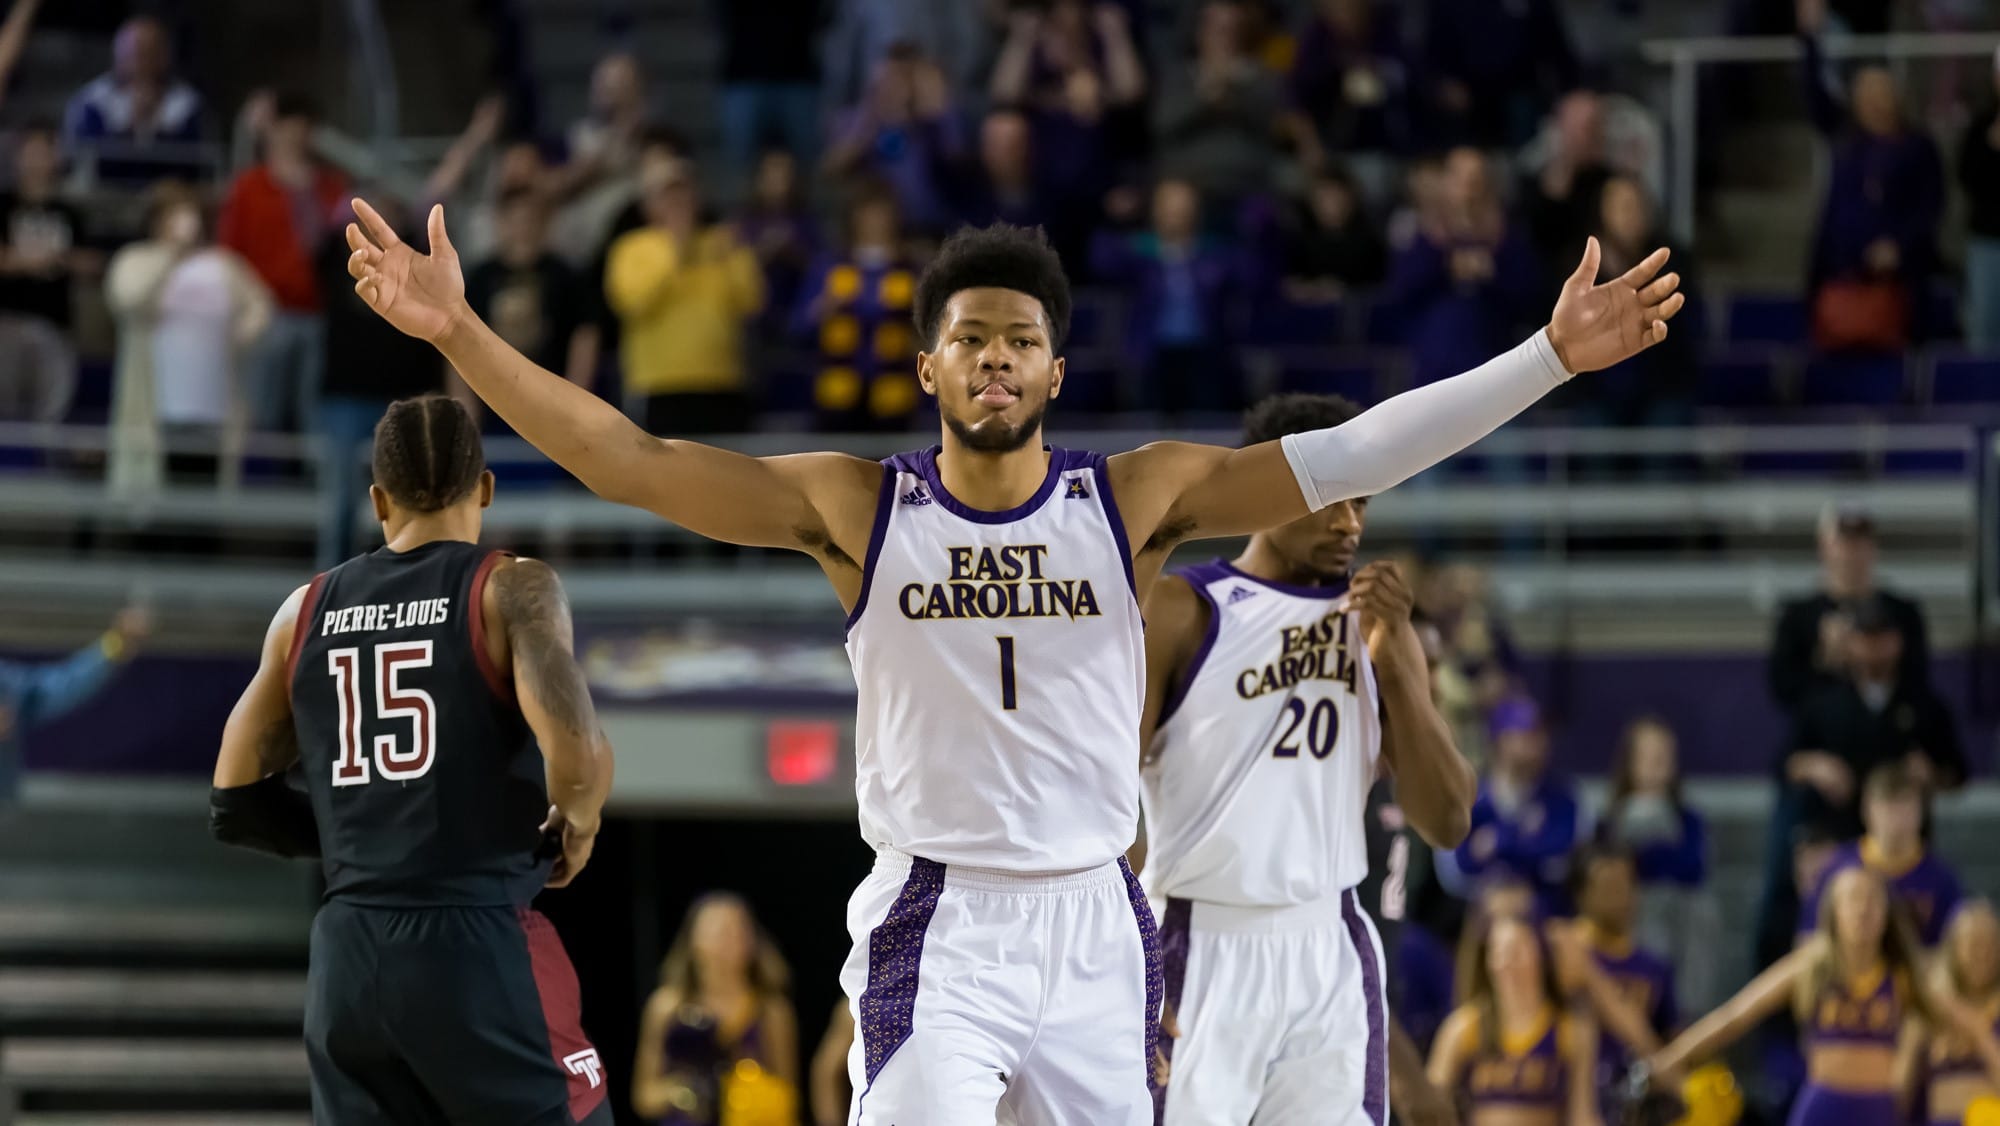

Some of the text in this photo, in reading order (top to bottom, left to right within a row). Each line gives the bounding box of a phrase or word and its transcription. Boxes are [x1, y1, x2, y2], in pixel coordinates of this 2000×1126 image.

[946, 544, 1048, 581] EAST
[321, 598, 450, 636] PIERRE-LOUIS
[898, 580, 1103, 623] CAROLINA
[995, 636, 1018, 710] 1
[328, 640, 437, 786] 15
[1272, 696, 1339, 761] 20
